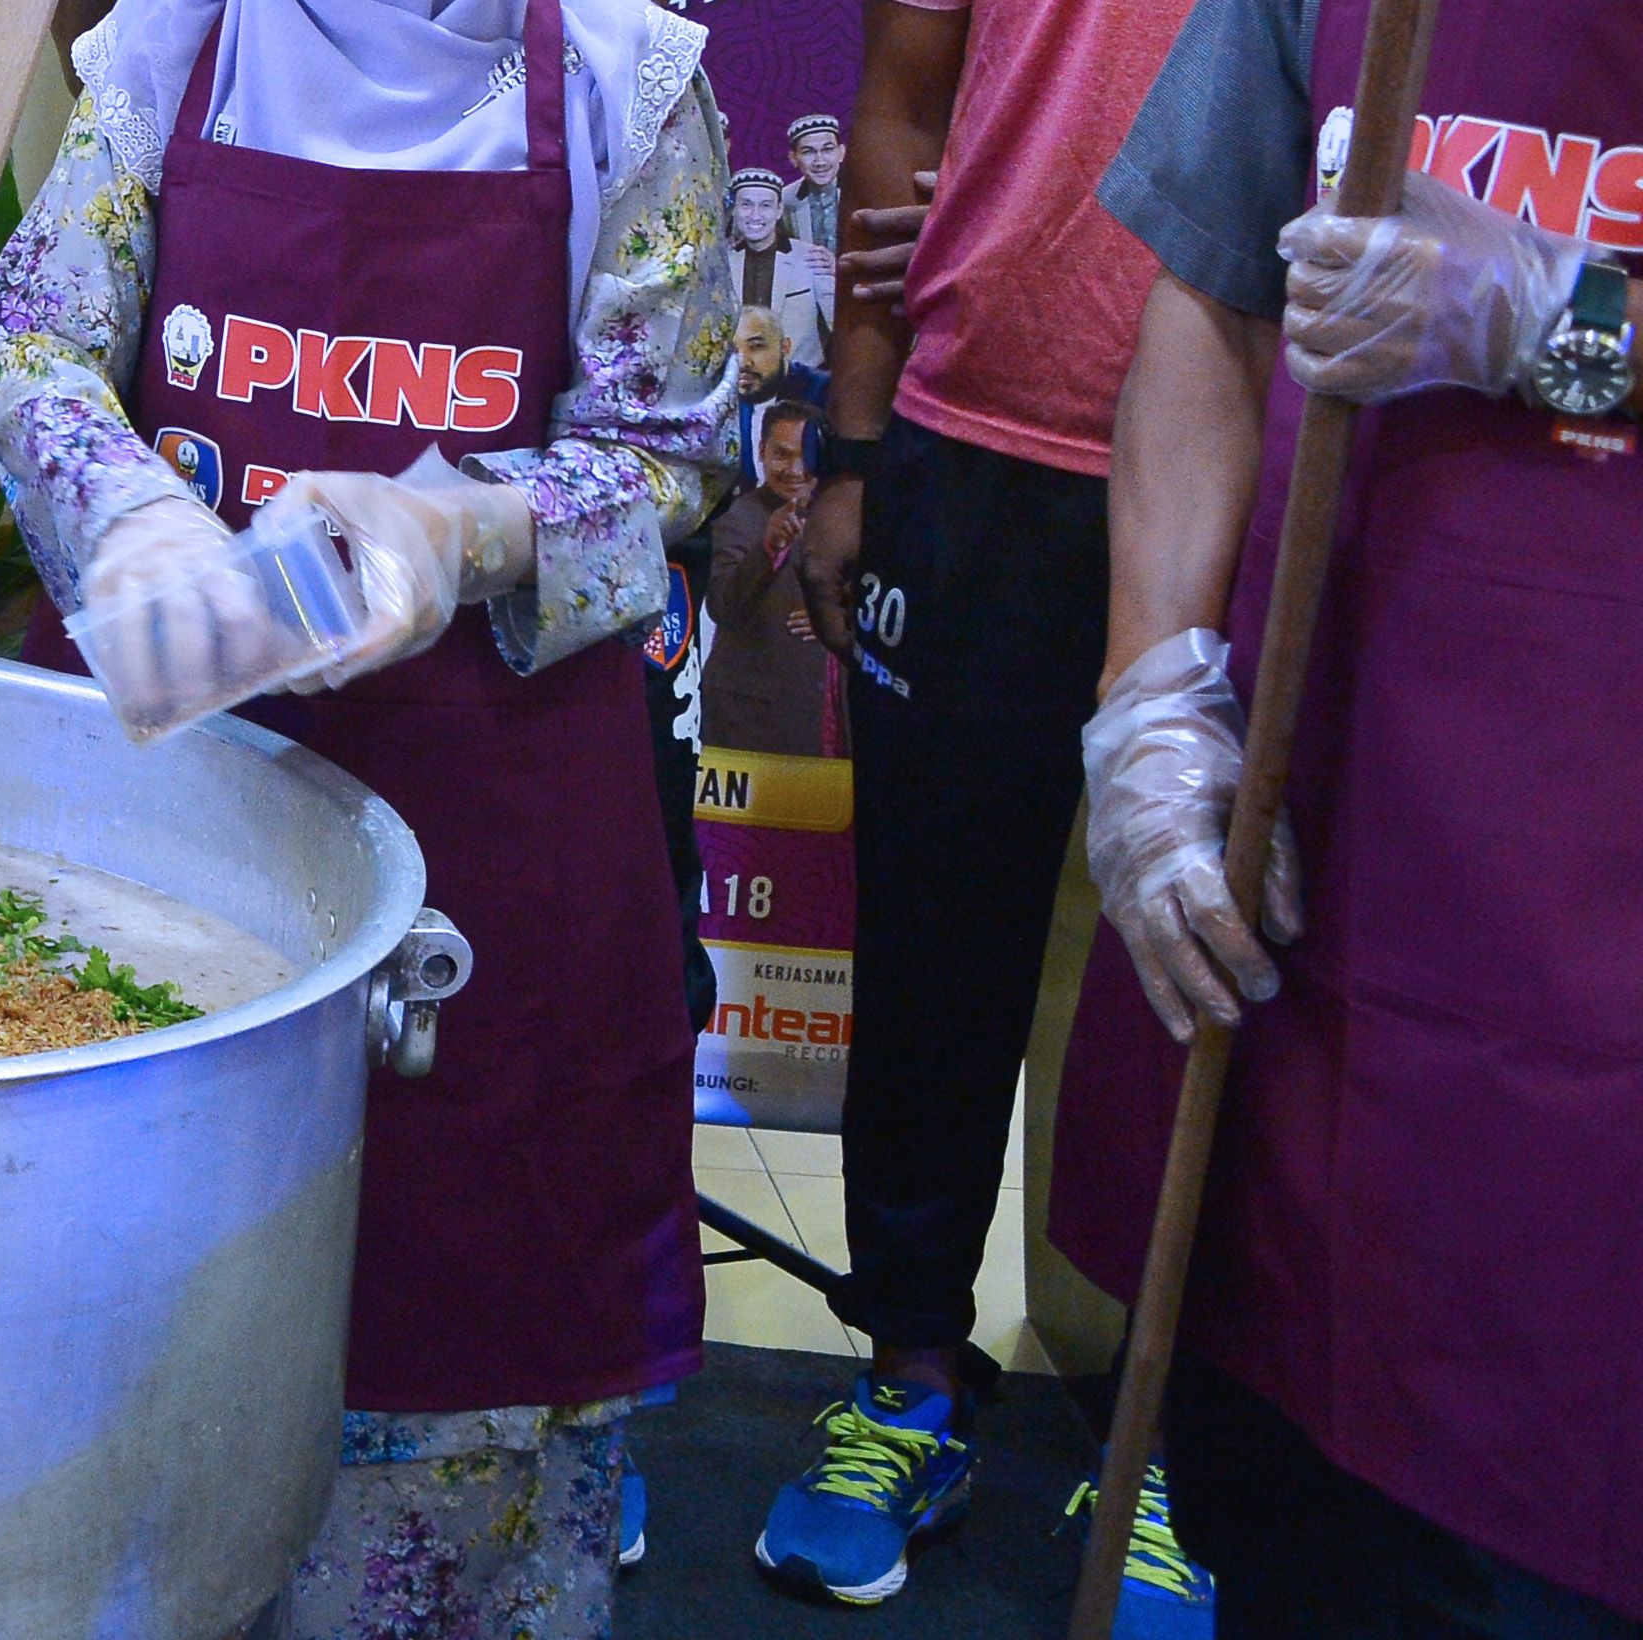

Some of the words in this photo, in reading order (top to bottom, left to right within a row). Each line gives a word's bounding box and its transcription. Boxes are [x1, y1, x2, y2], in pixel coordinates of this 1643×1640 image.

[216, 314, 522, 432] PKNS
[857, 571, 906, 648] 30
[722, 874, 773, 920] 18
